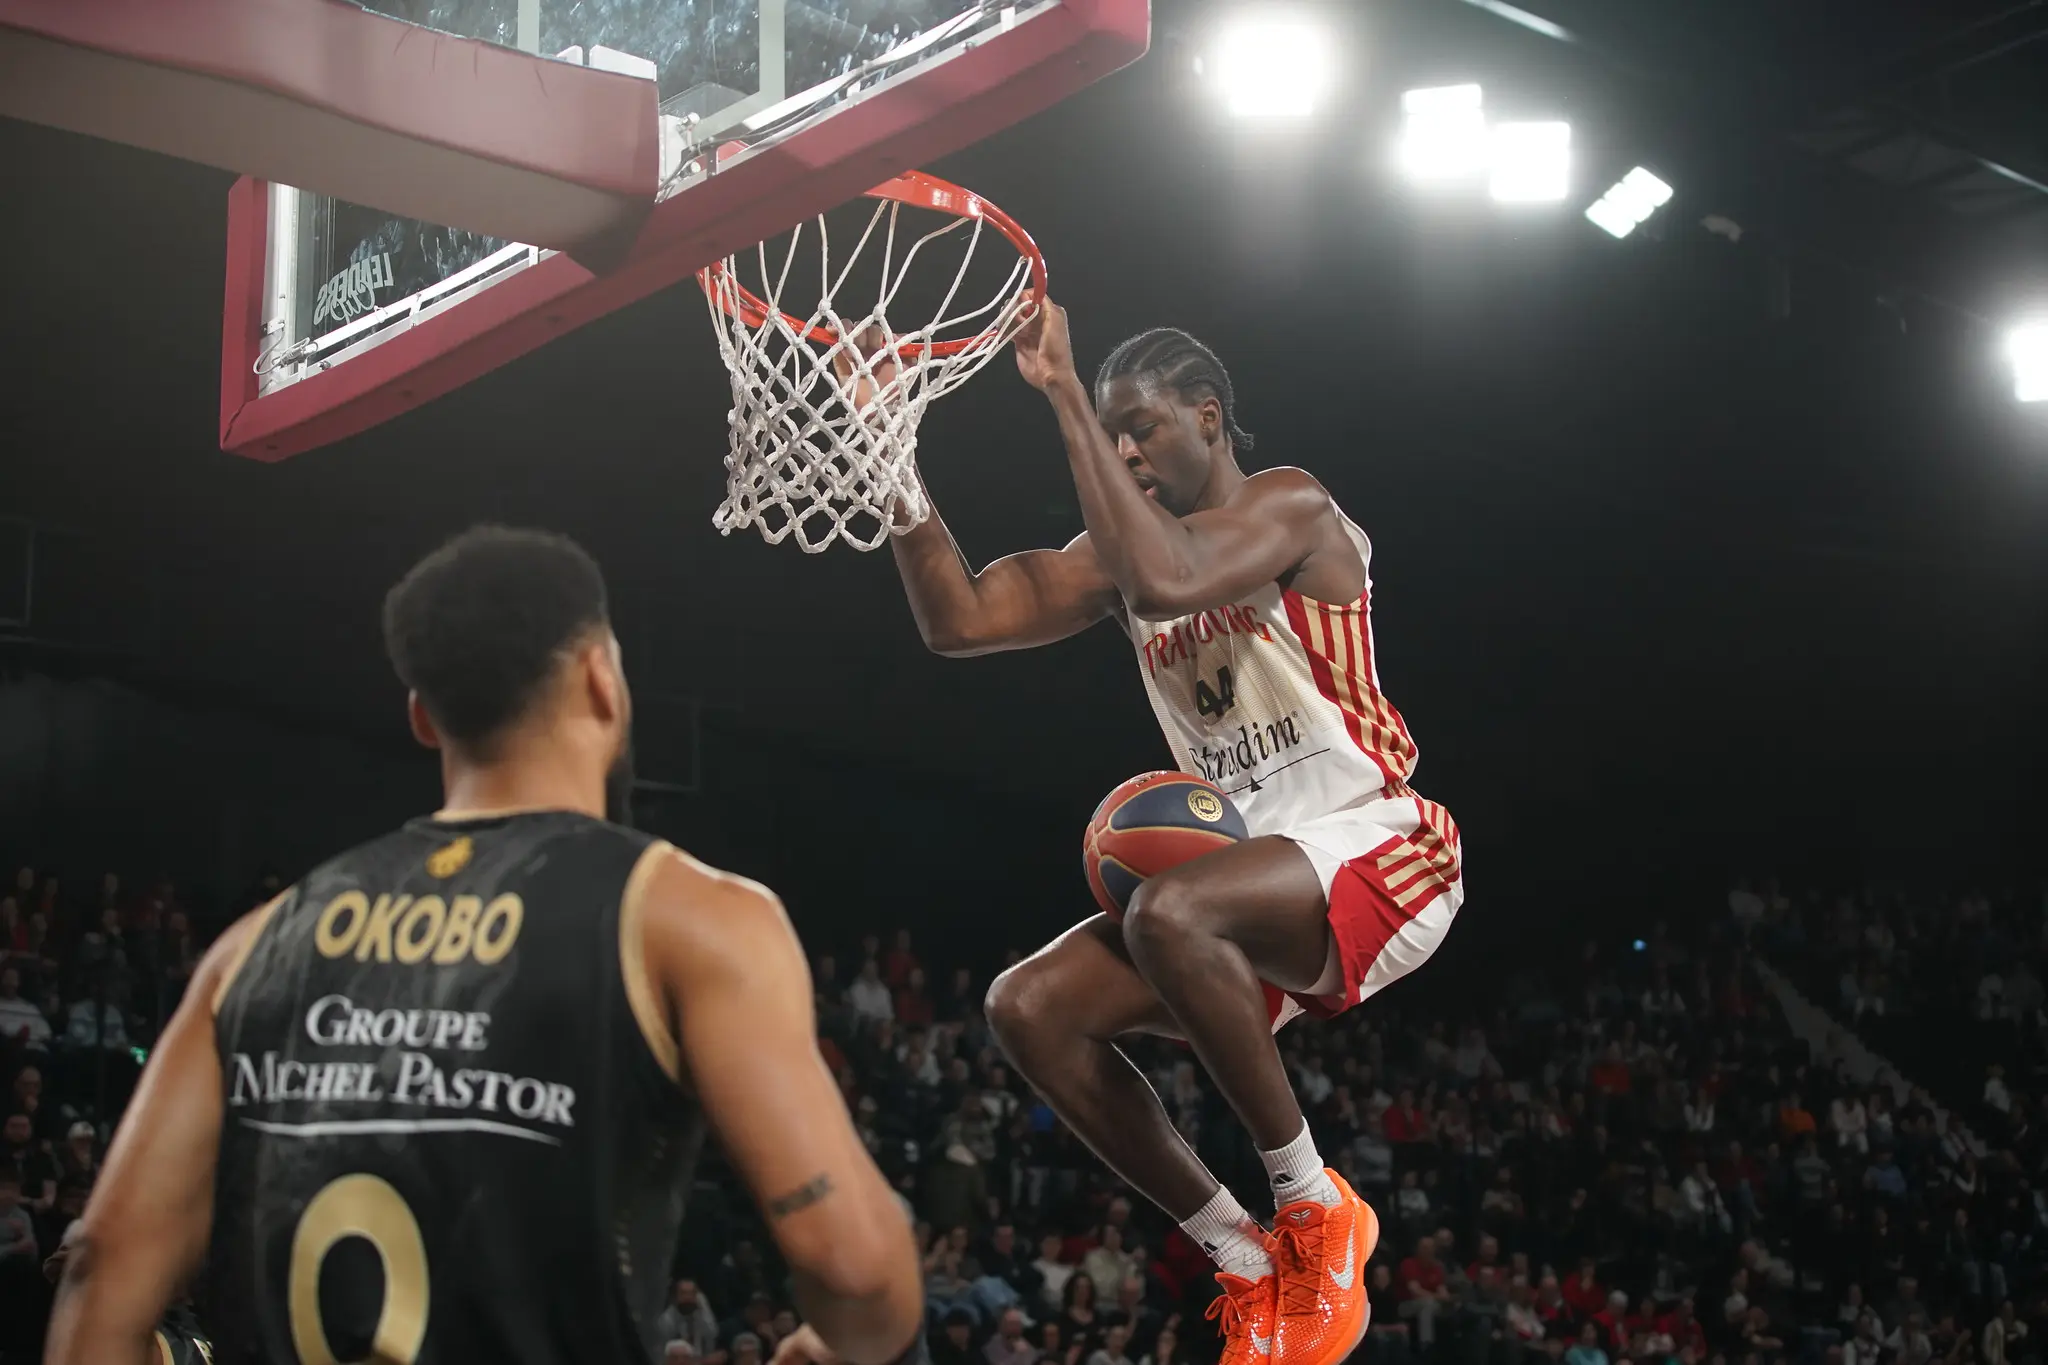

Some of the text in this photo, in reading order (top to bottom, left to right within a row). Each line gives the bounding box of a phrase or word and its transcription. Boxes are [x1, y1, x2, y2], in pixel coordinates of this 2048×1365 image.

[1196, 664, 1235, 718] 44
[314, 889, 525, 966] OKOBO
[305, 993, 492, 1051] GROUPE
[394, 1051, 576, 1127] PASTOR
[287, 1172, 431, 1365] 0
